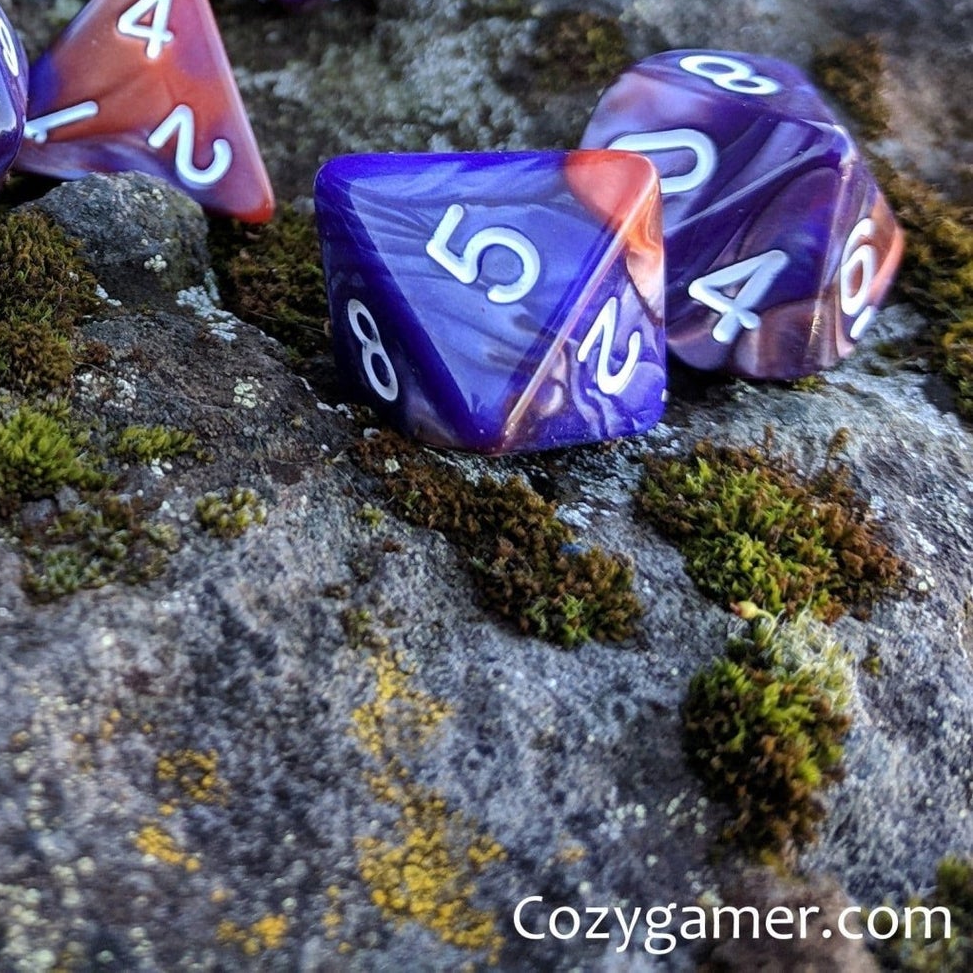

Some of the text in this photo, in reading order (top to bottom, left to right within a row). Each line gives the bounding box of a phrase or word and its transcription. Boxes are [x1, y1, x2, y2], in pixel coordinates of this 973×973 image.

[680, 55, 782, 95] 8
[147, 104, 233, 184] 2
[426, 203, 541, 304] 5
[688, 249, 790, 343] 4
[347, 298, 399, 402] 8
[577, 296, 641, 395] 2
